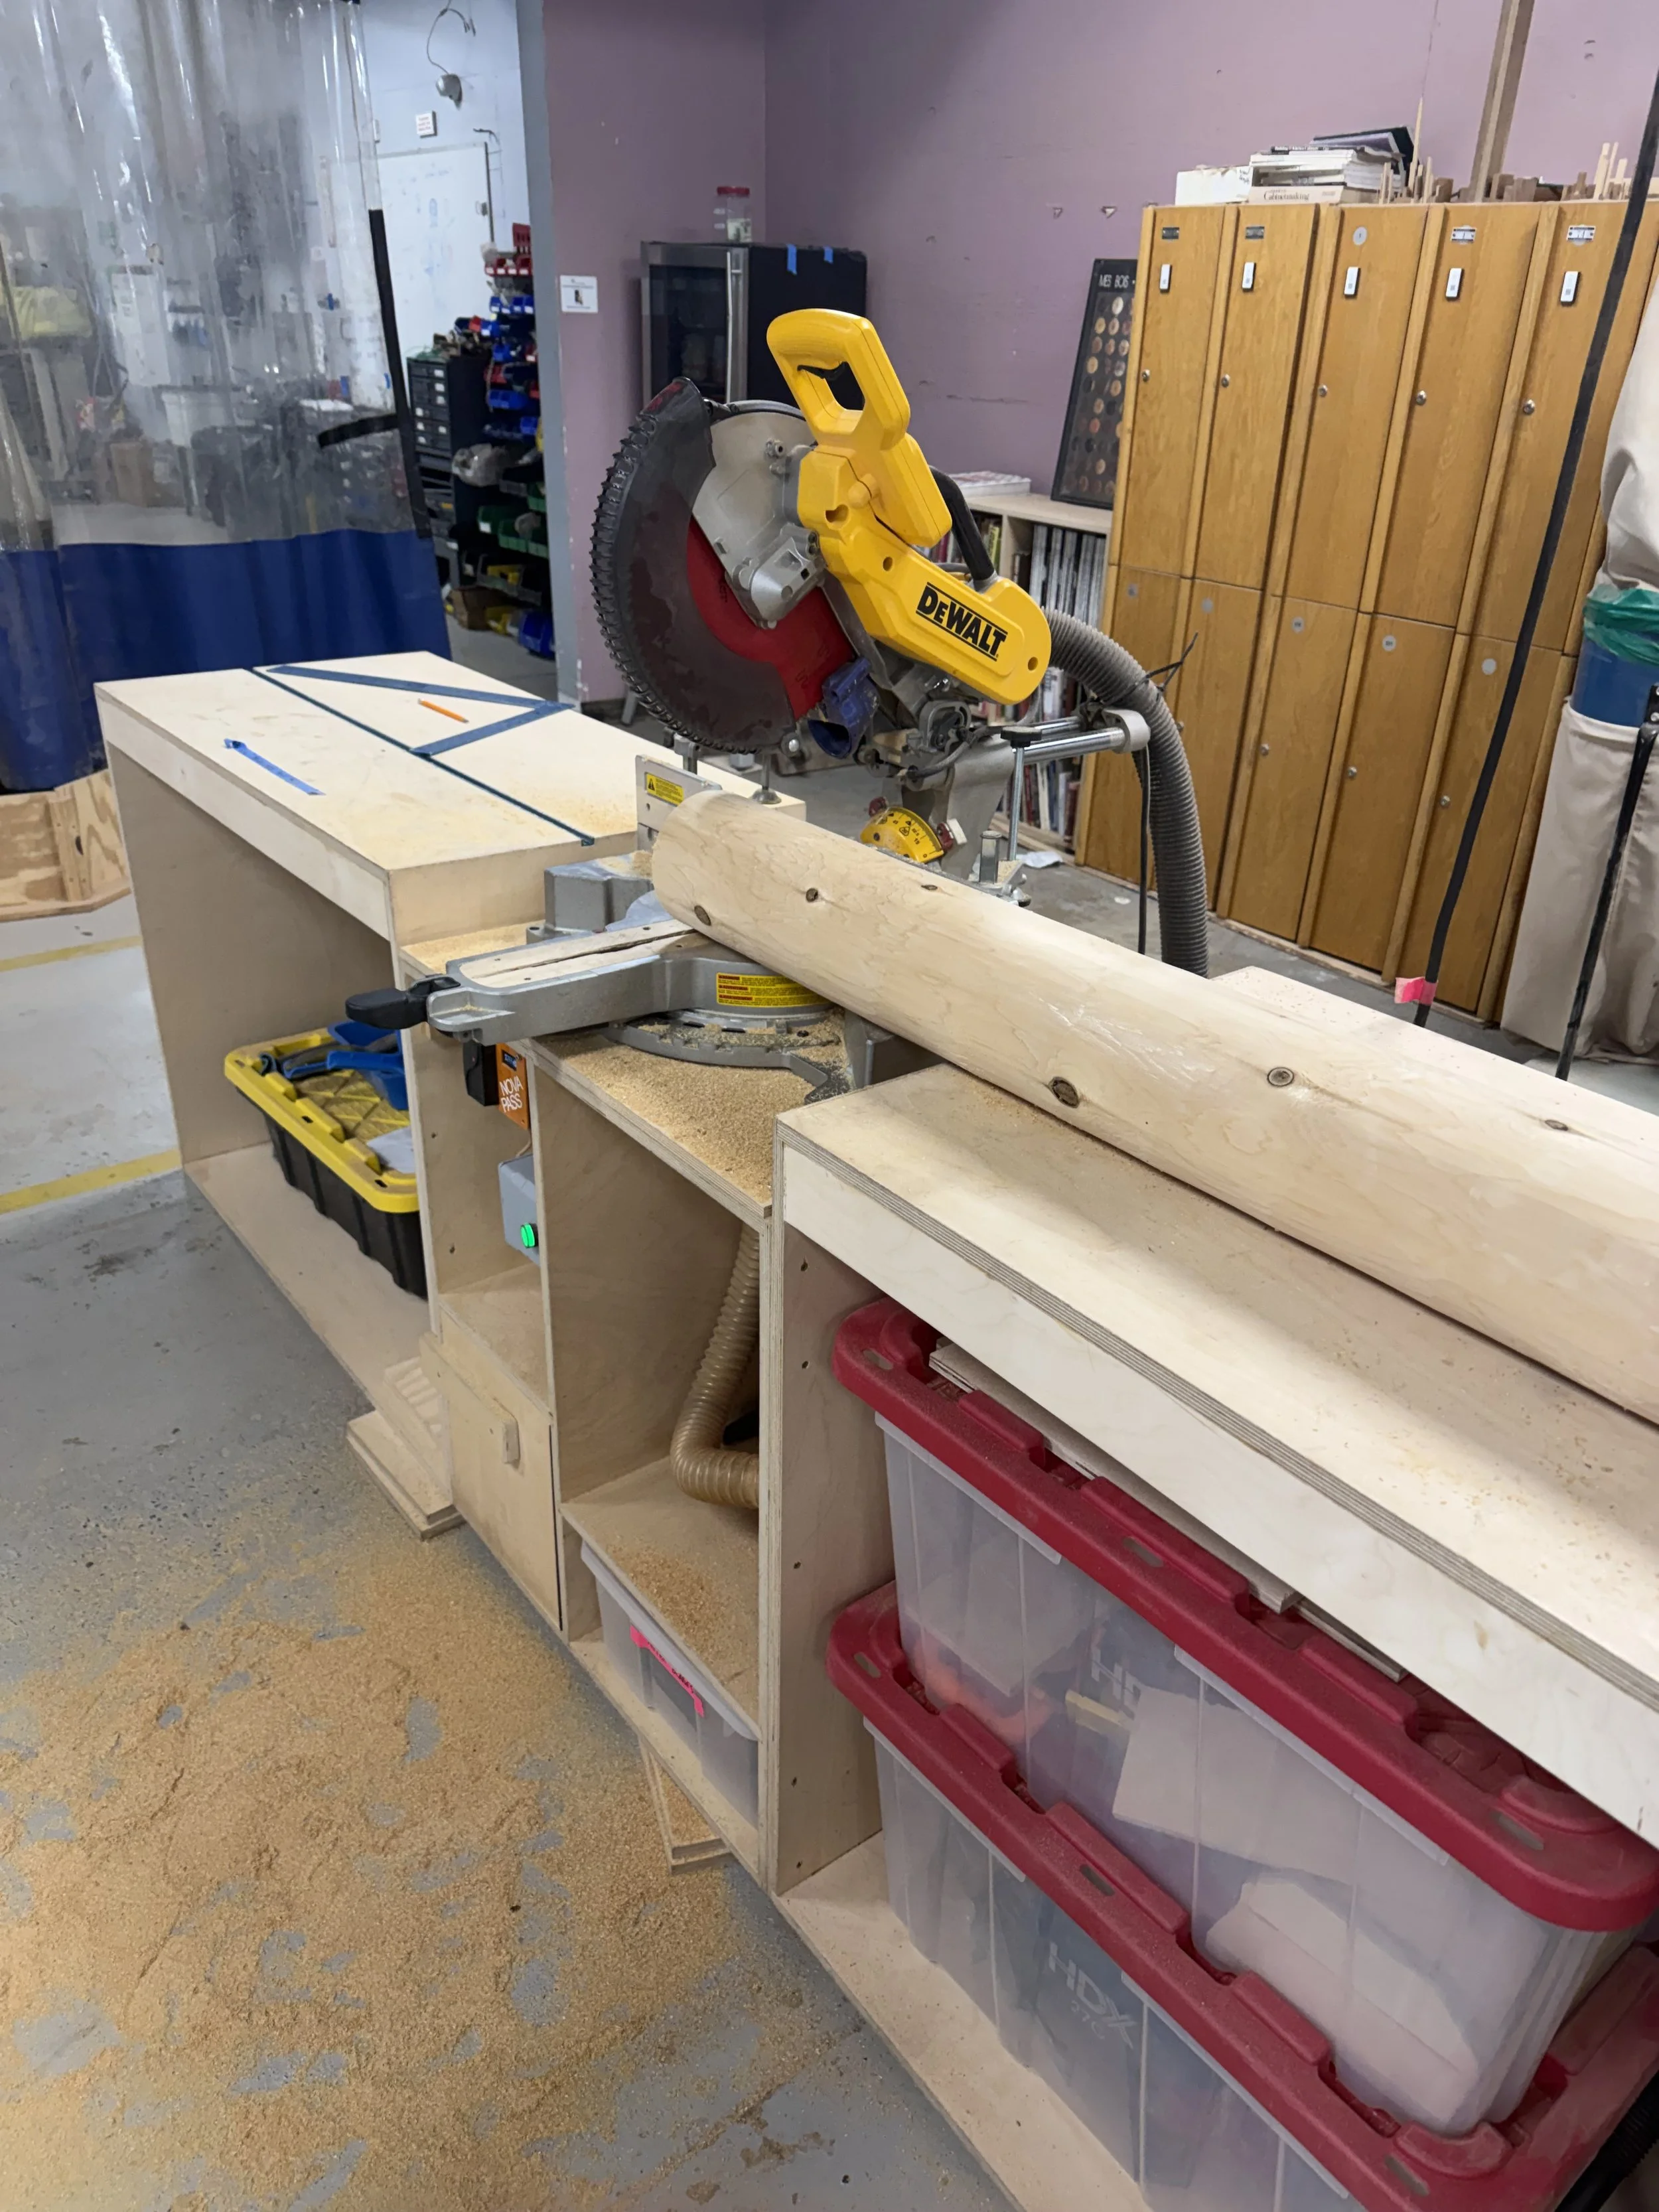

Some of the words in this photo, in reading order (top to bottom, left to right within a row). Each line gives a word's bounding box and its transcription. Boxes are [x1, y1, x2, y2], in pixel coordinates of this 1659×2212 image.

[500, 1075, 524, 1096] NOVA
[501, 1093, 522, 1112] PASS
[1048, 1941, 1139, 2048] HDX
